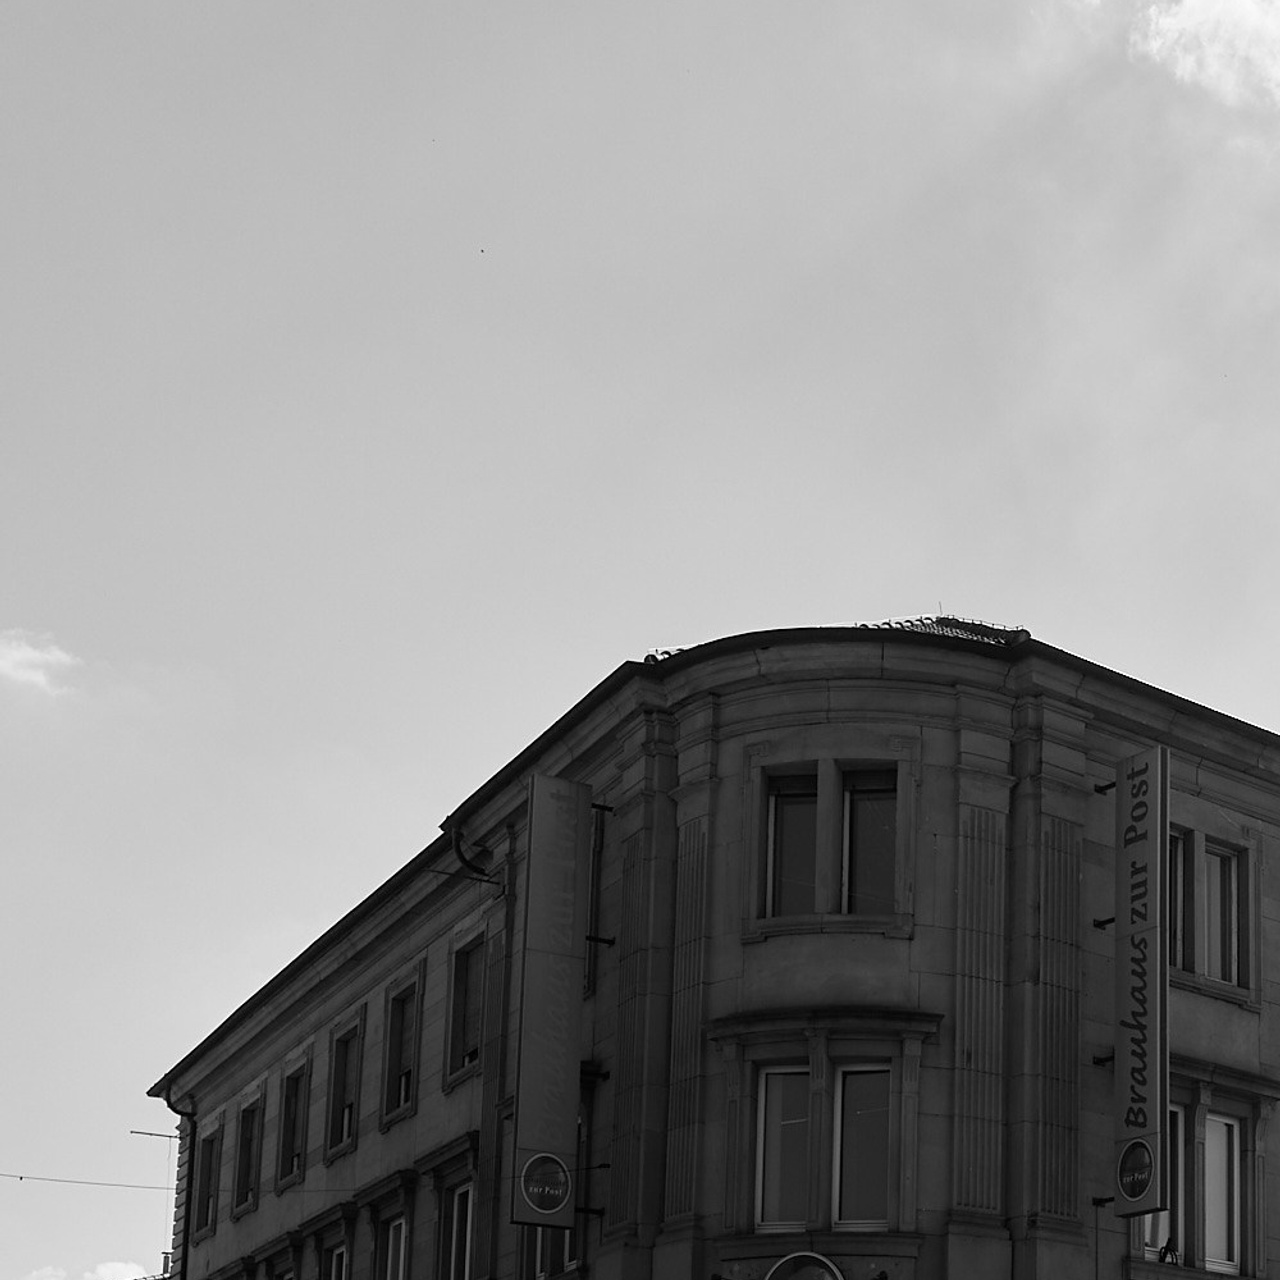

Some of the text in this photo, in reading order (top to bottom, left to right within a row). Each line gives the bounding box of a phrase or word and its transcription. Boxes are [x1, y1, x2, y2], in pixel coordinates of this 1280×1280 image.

[1118, 761, 1149, 1129] Brauhaus zur Post
